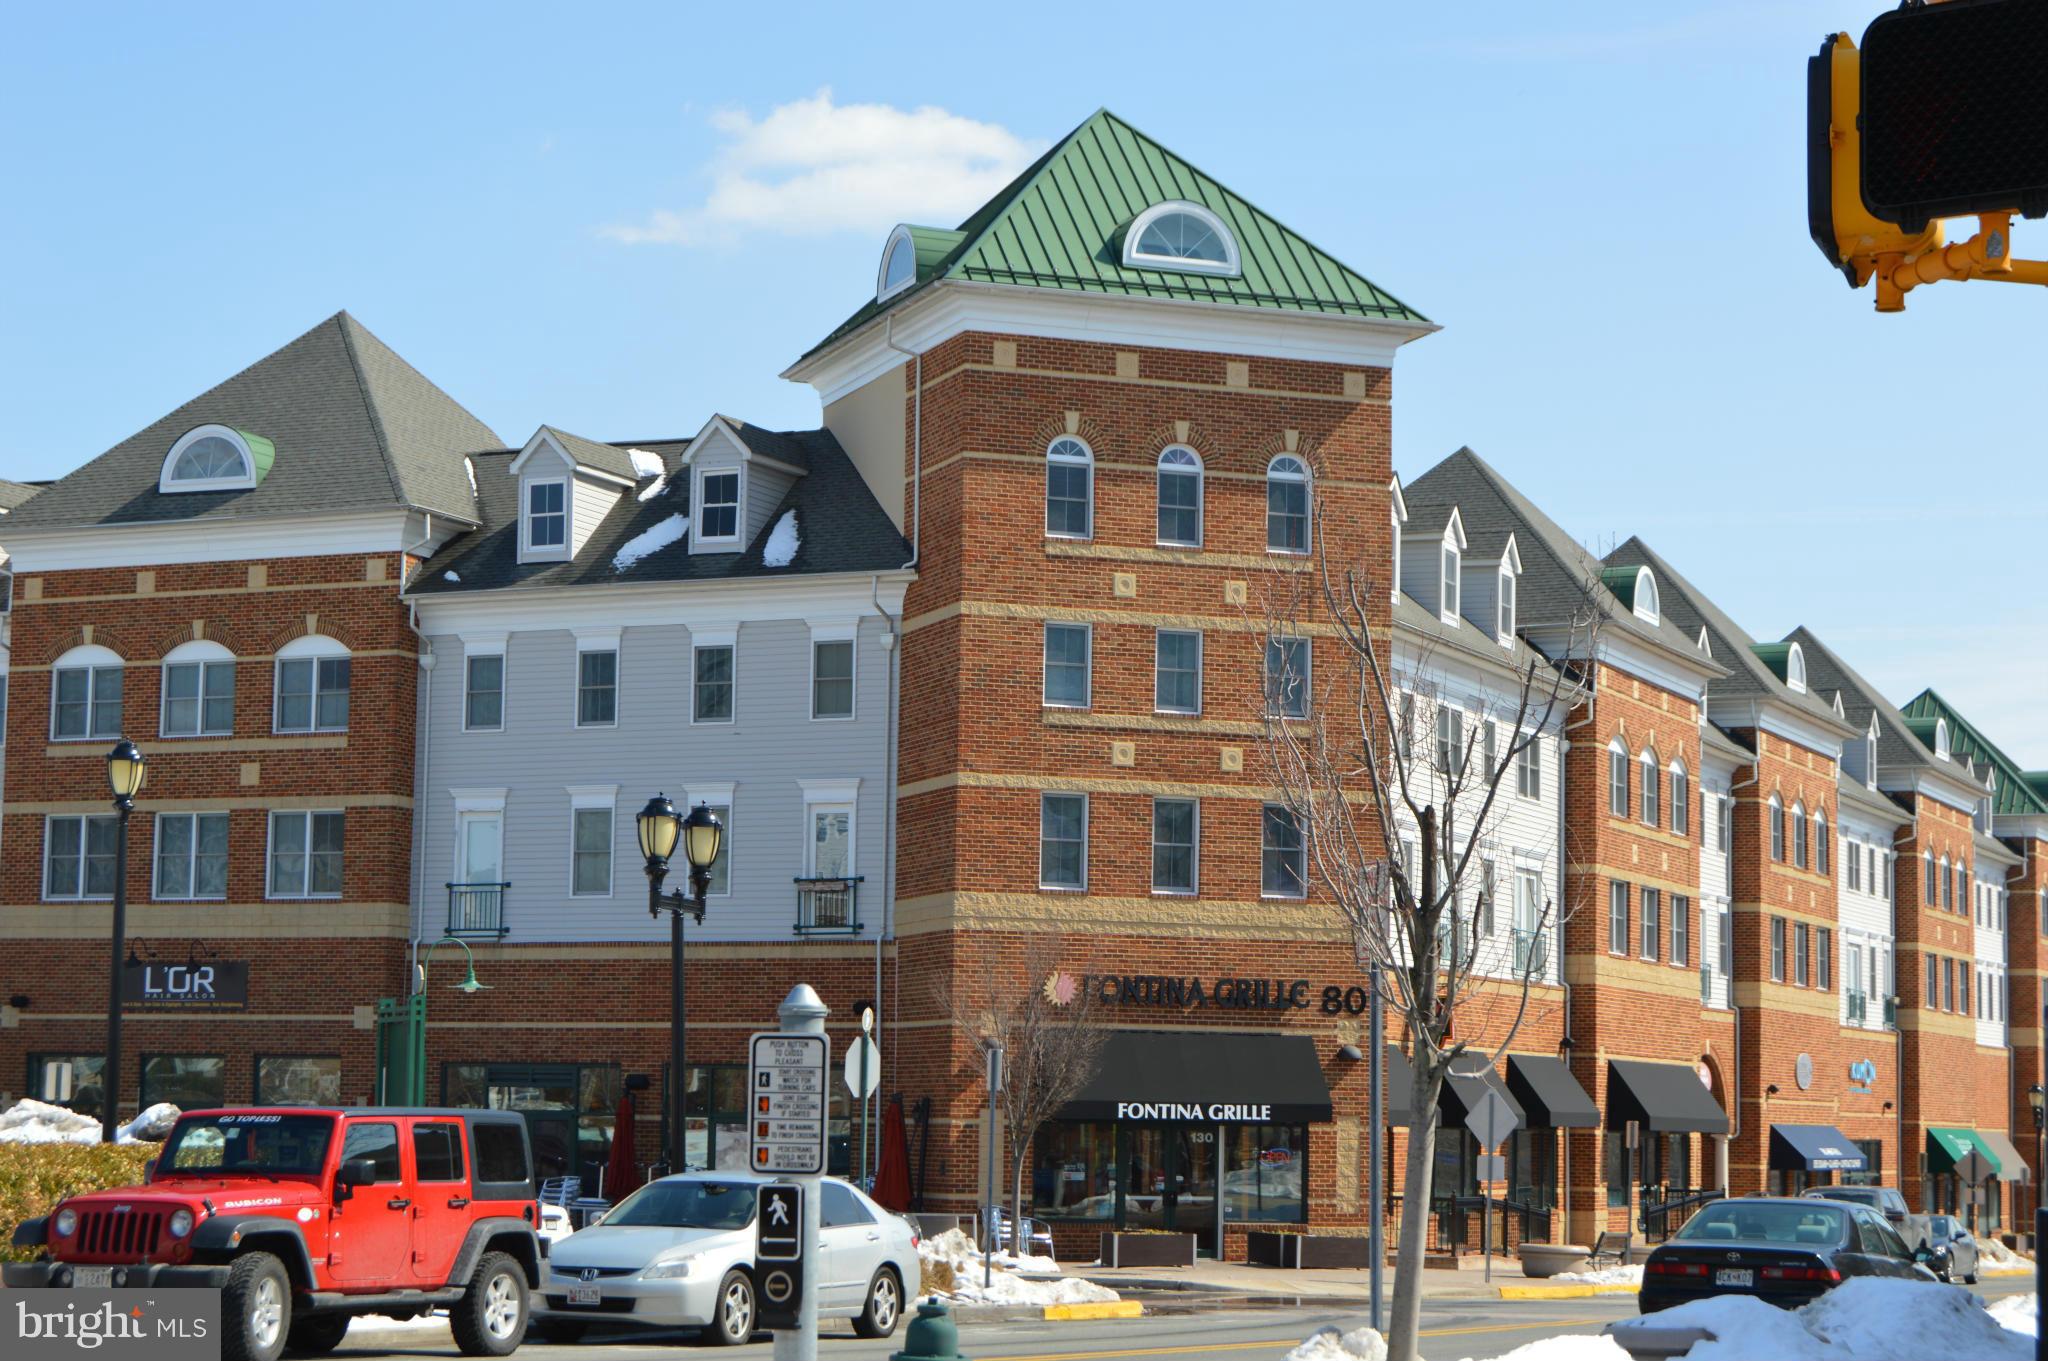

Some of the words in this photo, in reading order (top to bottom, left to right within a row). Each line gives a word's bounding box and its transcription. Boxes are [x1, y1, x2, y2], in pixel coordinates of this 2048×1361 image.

[144, 966, 215, 993] L'OR
[1083, 975, 1208, 1009] FONTINA
[1213, 977, 1312, 1010] GRILLE
[1321, 986, 1367, 1015] 80
[1118, 1102, 1204, 1120] FONTINA
[1208, 1104, 1271, 1121] GRILLE
[1190, 1132, 1214, 1144] 130
[1260, 1150, 1292, 1164] OPEN
[224, 1197, 282, 1208] RUBICON
